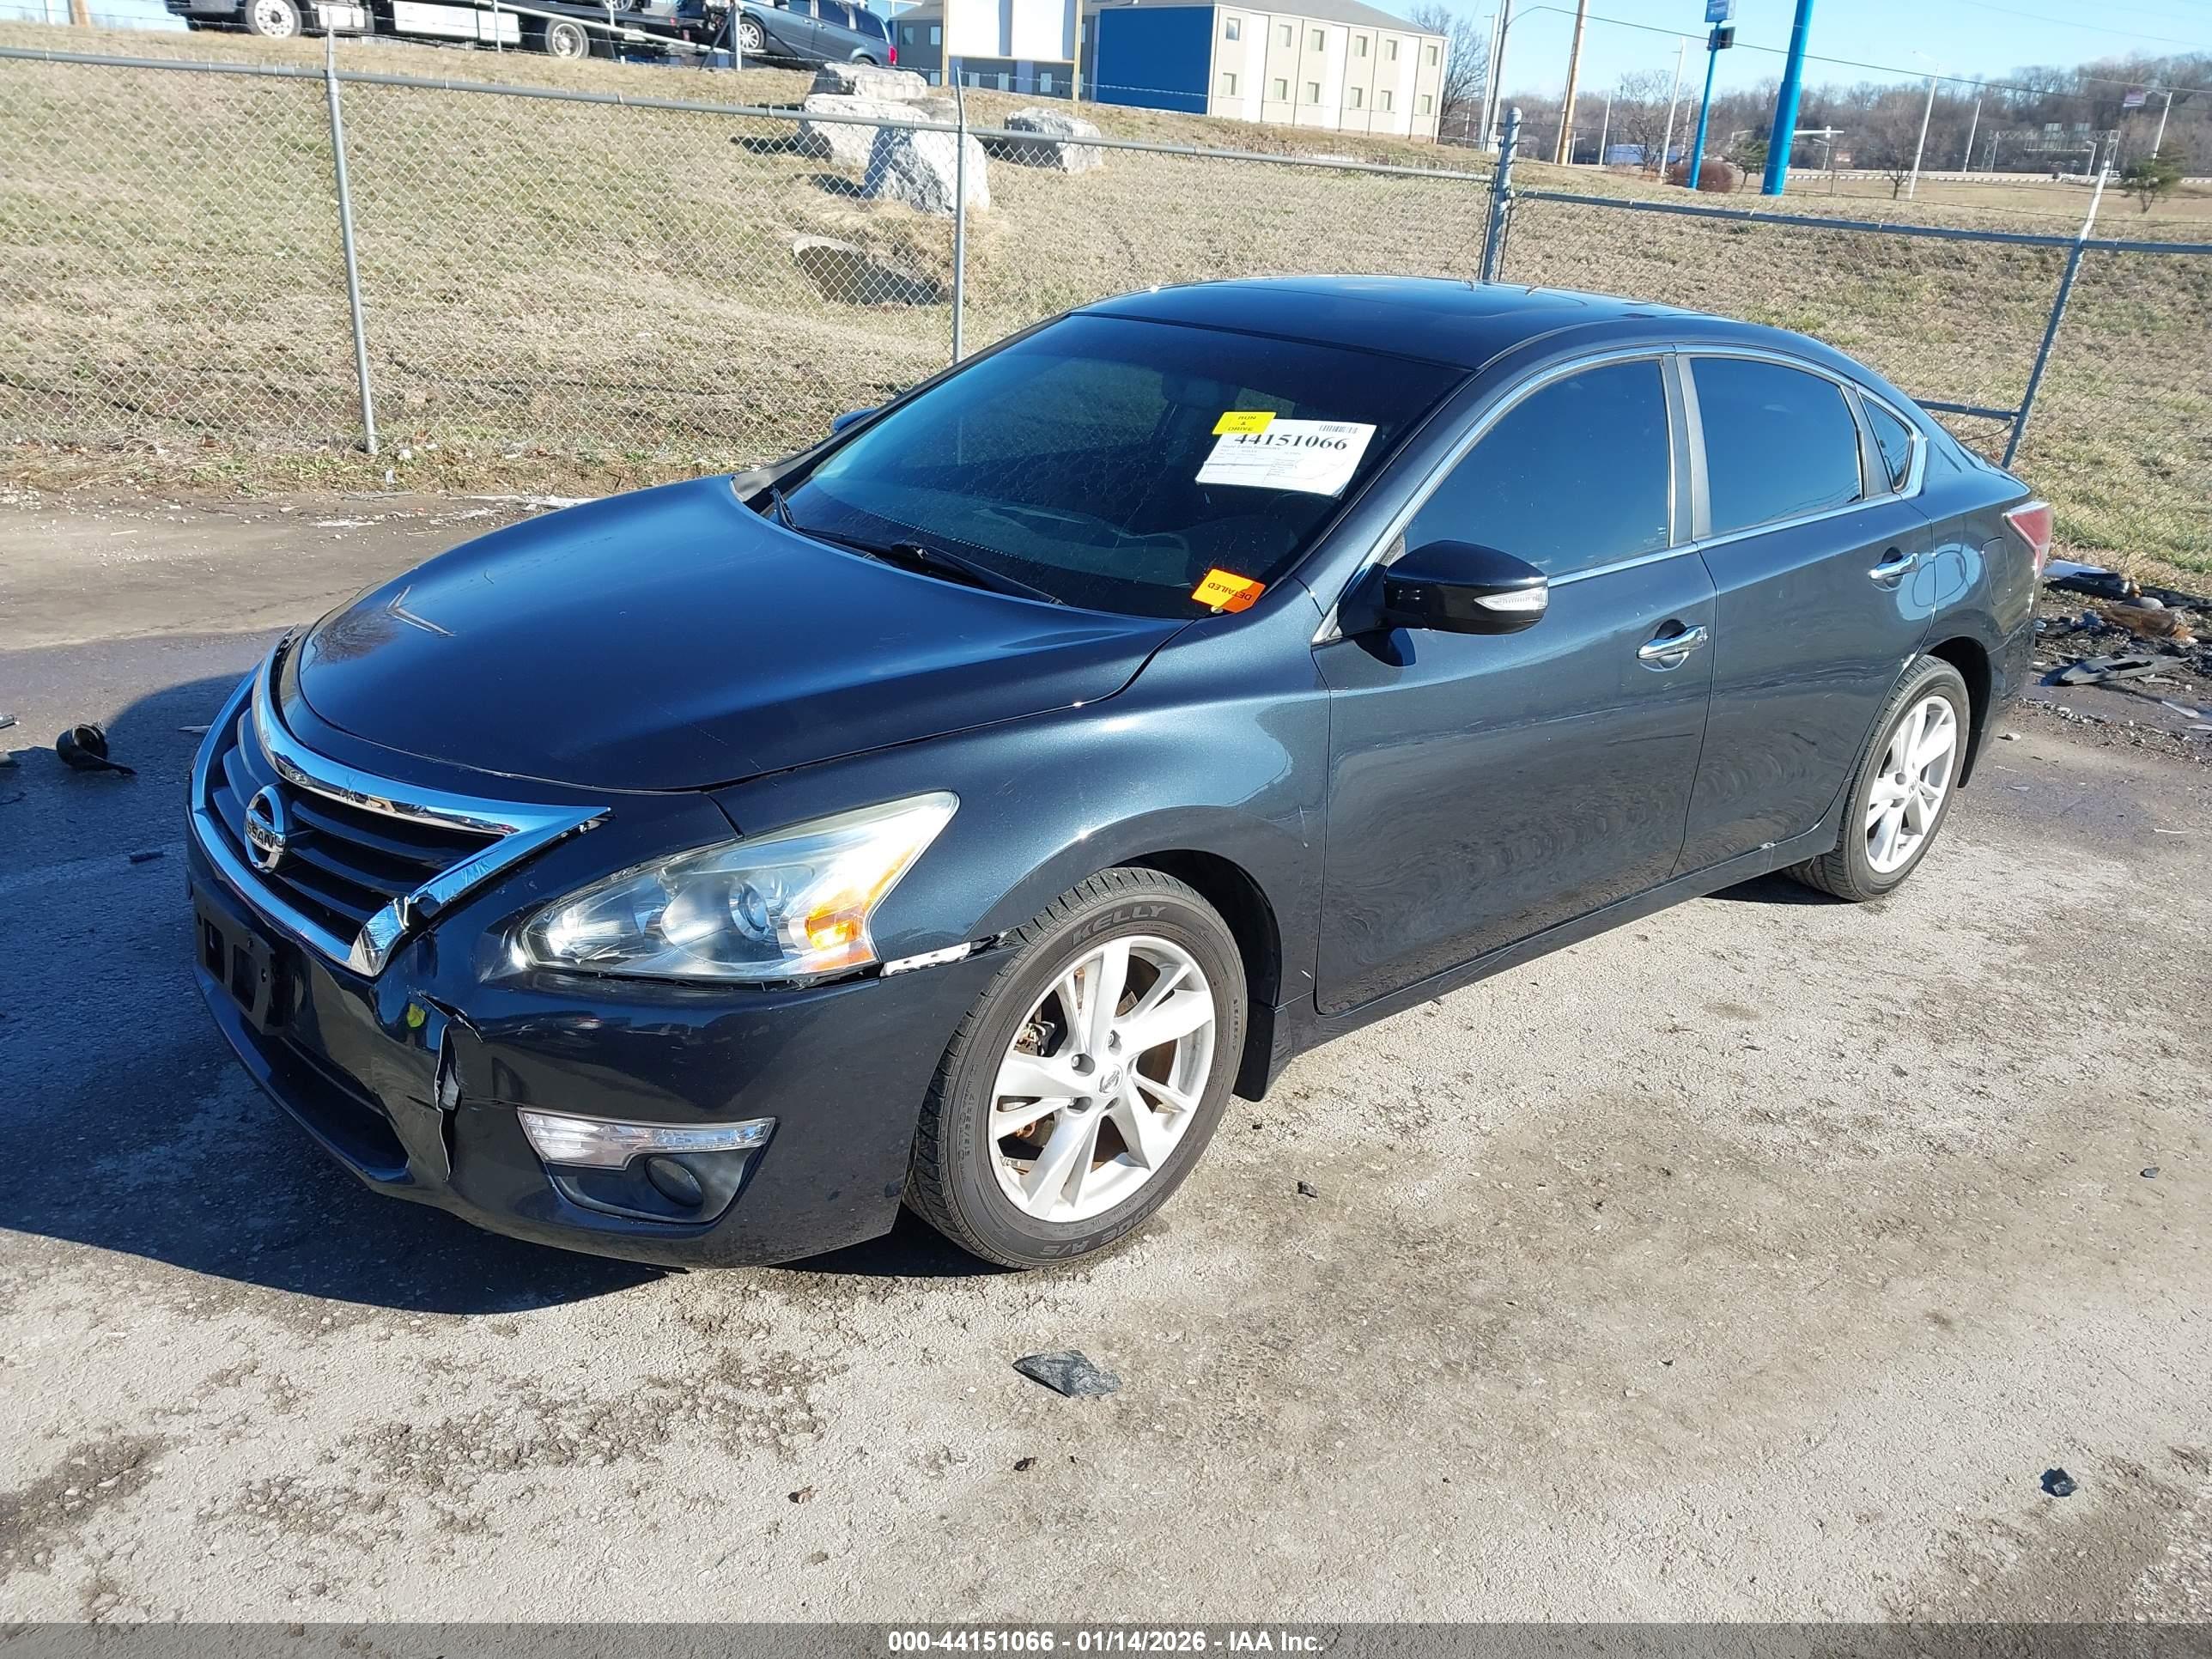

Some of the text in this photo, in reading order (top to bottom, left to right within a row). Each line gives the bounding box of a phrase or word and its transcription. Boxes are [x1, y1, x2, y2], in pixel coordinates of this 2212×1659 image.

[1234, 433, 1348, 451] 44151066
[1207, 581, 1253, 601] DETAILED
[246, 817, 275, 848] SSAN
[1073, 905, 1169, 945] KELLY
[1100, 1191, 1164, 1244] EDGE
